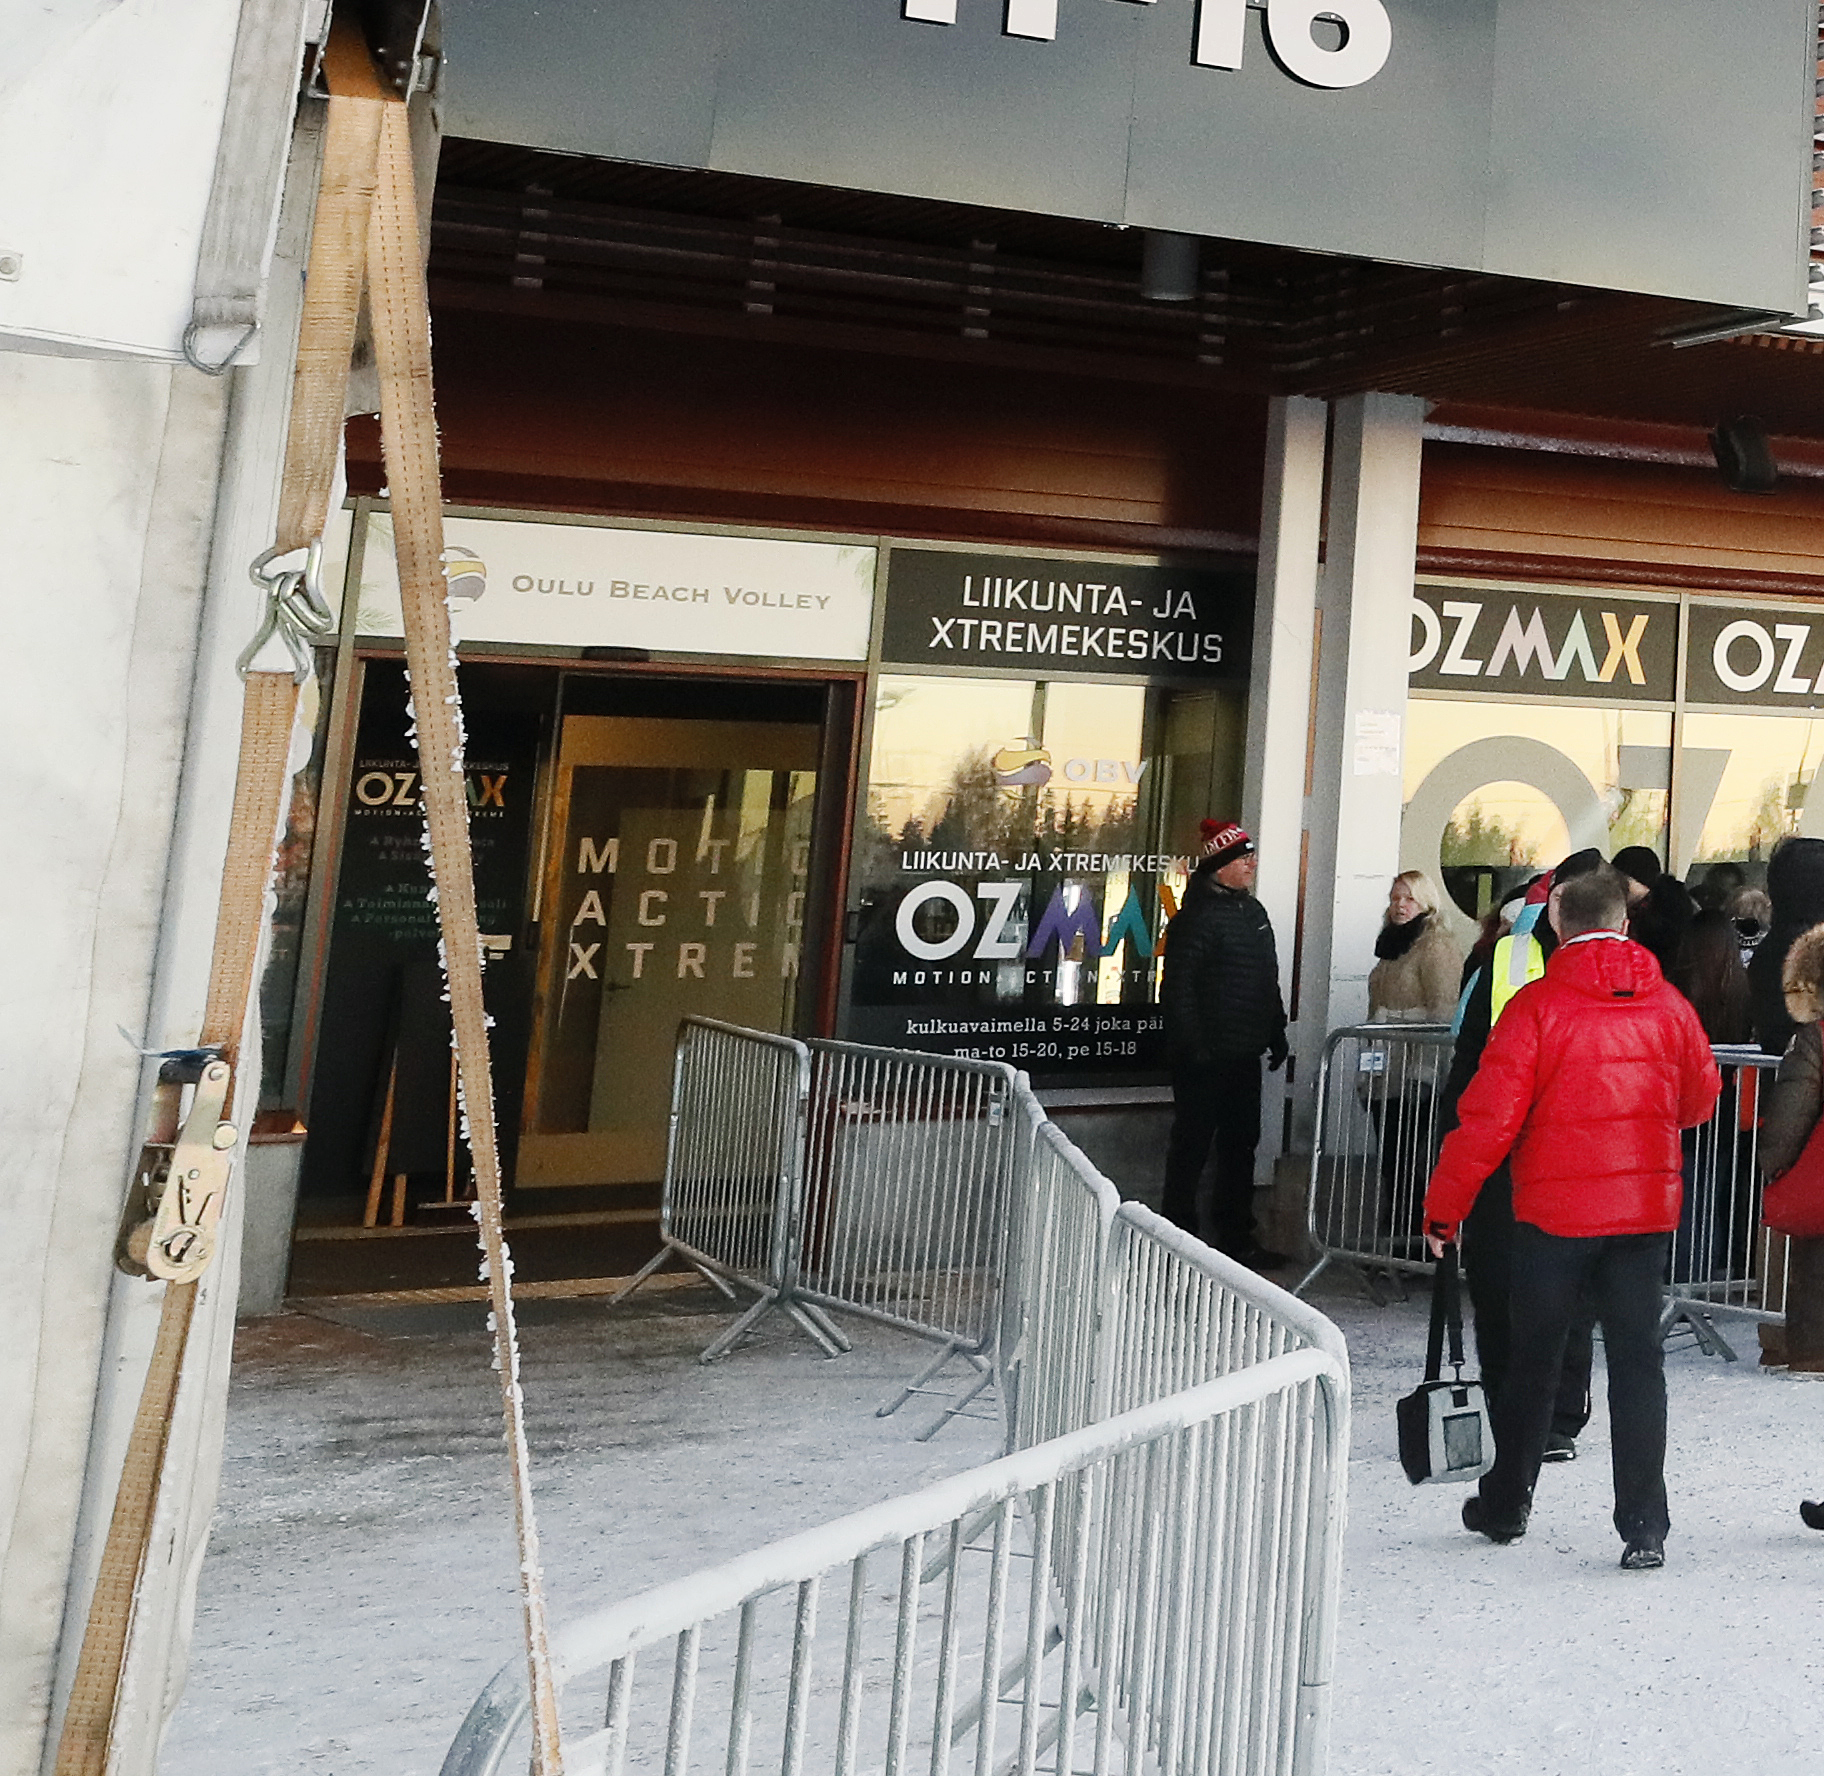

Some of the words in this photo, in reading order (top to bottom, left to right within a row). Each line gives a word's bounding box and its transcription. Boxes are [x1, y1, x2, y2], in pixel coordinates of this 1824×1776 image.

[962, 575, 1142, 617] LIIKUNTA-
[1152, 586, 1197, 621] JA
[929, 617, 1224, 664] XTREMEKESKUS
[1063, 757, 1148, 785] OBV
[901, 850, 1009, 871] LIIKUNTA-
[1014, 852, 1042, 872] JA
[1048, 852, 1200, 873] XTREMEKESKU
[893, 970, 992, 985] MOTION
[906, 1018, 1047, 1035] kulkuavaimella
[1052, 1017, 1090, 1032] 5-24
[1093, 1016, 1133, 1036] joka
[1137, 1016, 1164, 1036] päi
[953, 1044, 1006, 1060] ma-to
[1011, 1042, 1062, 1059] 15-20,
[1068, 1045, 1090, 1060] pe
[1096, 1041, 1137, 1056] 15-18
